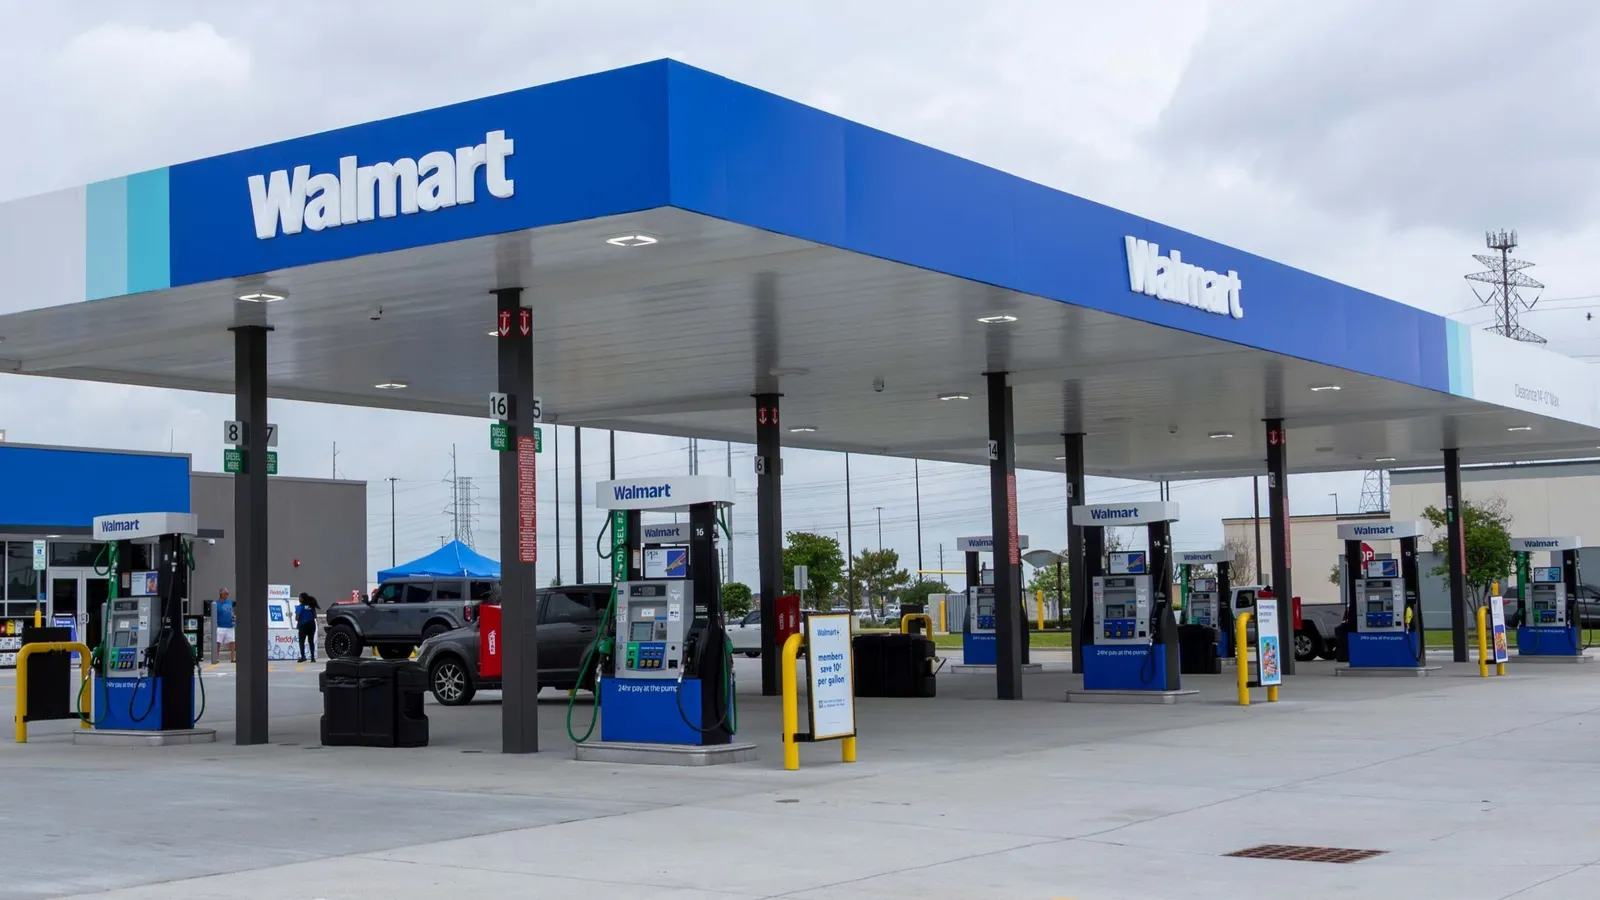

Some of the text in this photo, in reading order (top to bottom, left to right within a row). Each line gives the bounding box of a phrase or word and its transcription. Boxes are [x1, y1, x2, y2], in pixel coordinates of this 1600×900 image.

[248, 129, 515, 240] Walmart
[1124, 235, 1244, 319] Walmart
[490, 396, 507, 415] 16
[532, 400, 541, 419] 5
[228, 424, 239, 441] 8
[266, 426, 274, 445] 7
[491, 427, 507, 437] DIESEL
[493, 437, 505, 447] HERE
[988, 443, 998, 457] 14
[225, 452, 241, 461] DIESEL
[227, 461, 239, 470] HERE
[756, 458, 763, 472] 6
[614, 484, 671, 501] Walmart
[1091, 507, 1139, 520] Walmart
[101, 519, 140, 533] Walmart
[1353, 526, 1394, 536] Walmart
[644, 527, 680, 539] Walmart
[695, 528, 704, 537] 16
[616, 525, 625, 563] DISEL
[968, 539, 994, 548] Walma
[1524, 540, 1559, 549] Walmart
[1183, 553, 1212, 561] Walmart
[817, 652, 844, 662] members
[820, 665, 833, 674] save
[618, 684, 631, 692] 24hr
[631, 685, 643, 693] pay
[650, 684, 660, 692] the
[817, 678, 827, 688] per
